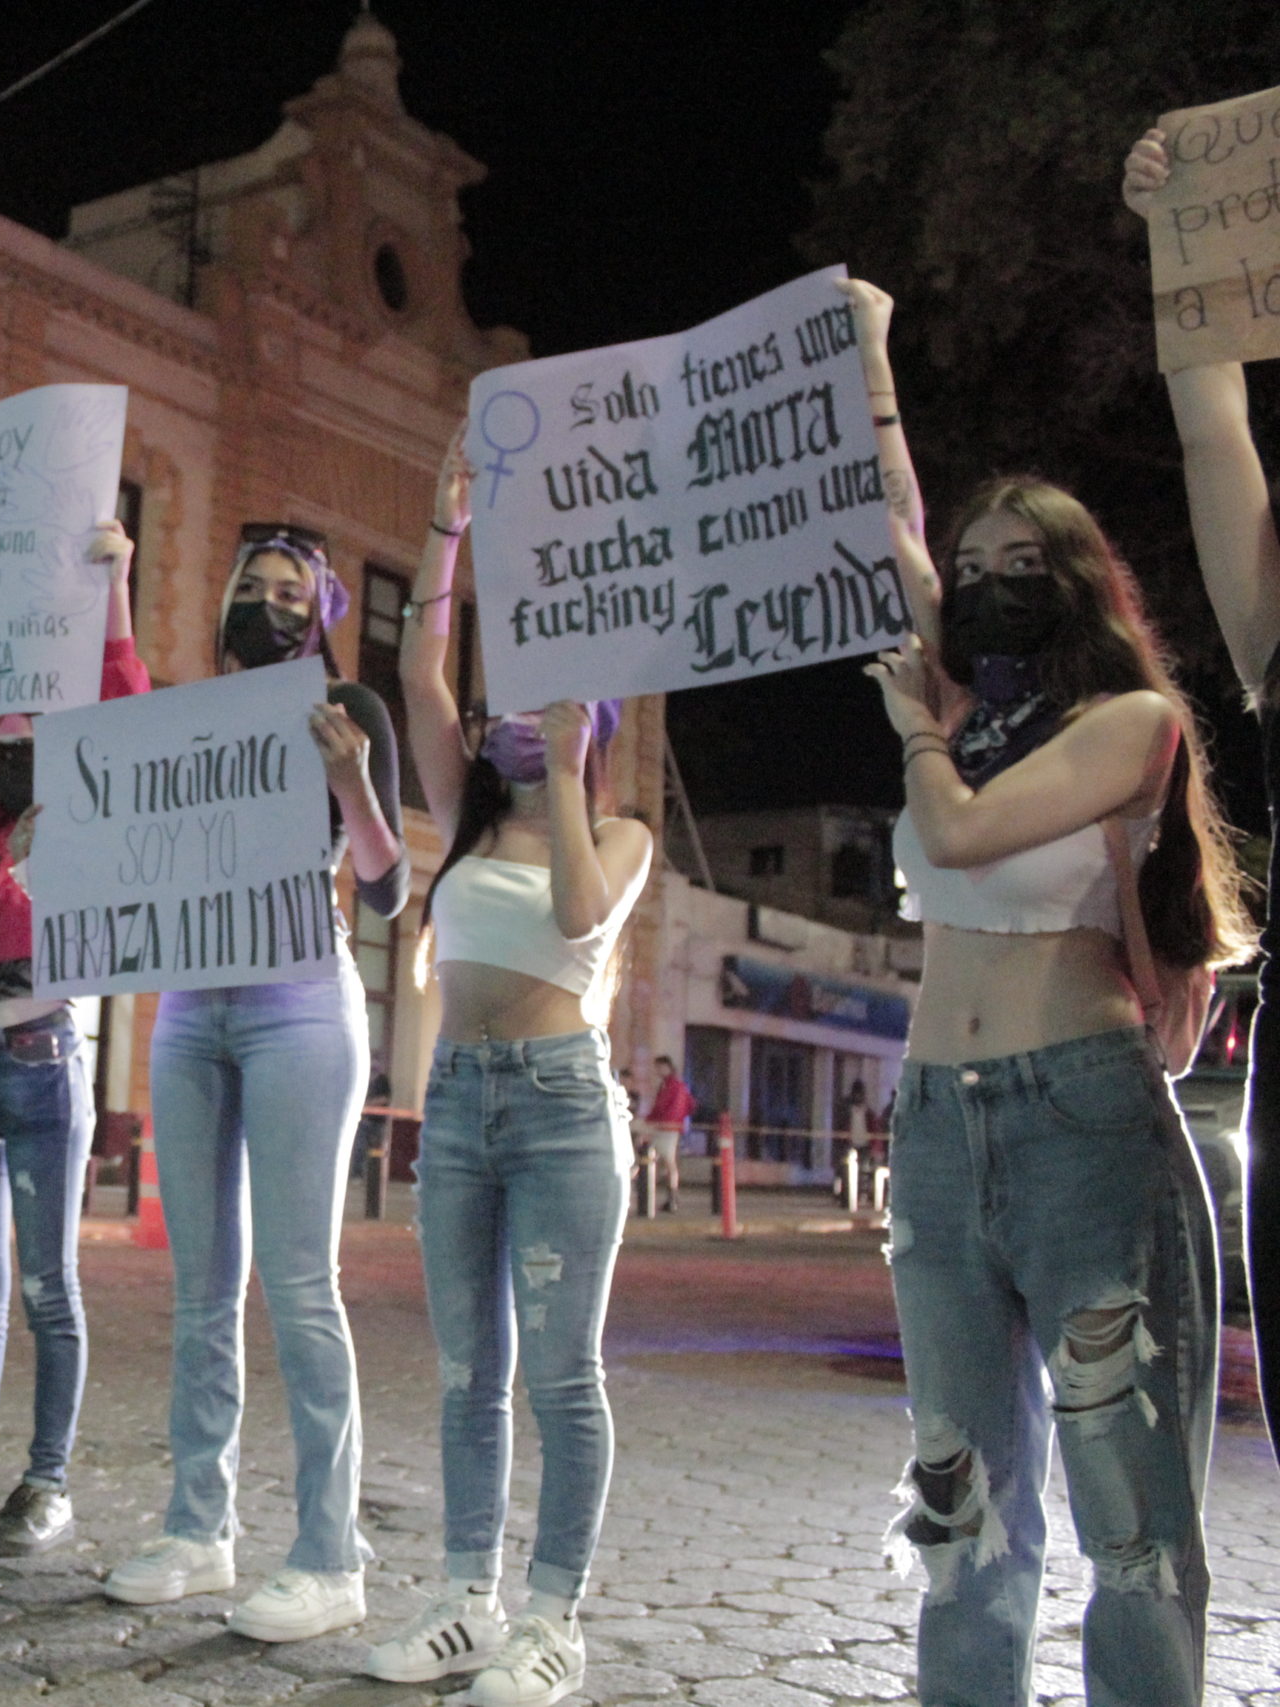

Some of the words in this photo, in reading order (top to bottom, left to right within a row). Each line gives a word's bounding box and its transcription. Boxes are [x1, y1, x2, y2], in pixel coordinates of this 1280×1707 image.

[1174, 286, 1209, 331] a
[569, 370, 660, 430] Solo
[679, 331, 786, 408] tienes
[795, 301, 858, 367] una
[685, 382, 842, 489] Morra
[530, 518, 674, 587] Lucha
[698, 486, 809, 556] como
[820, 453, 885, 514] una
[7, 611, 70, 639] niñas
[509, 577, 677, 647] fucking
[683, 540, 914, 674] Leyenda
[70, 735, 112, 824] Si
[131, 730, 288, 815] mañana
[119, 817, 183, 886] SOY
[198, 810, 237, 883] YO
[36, 902, 163, 985] ABRAZA
[174, 898, 193, 973] A
[199, 890, 236, 970] MI
